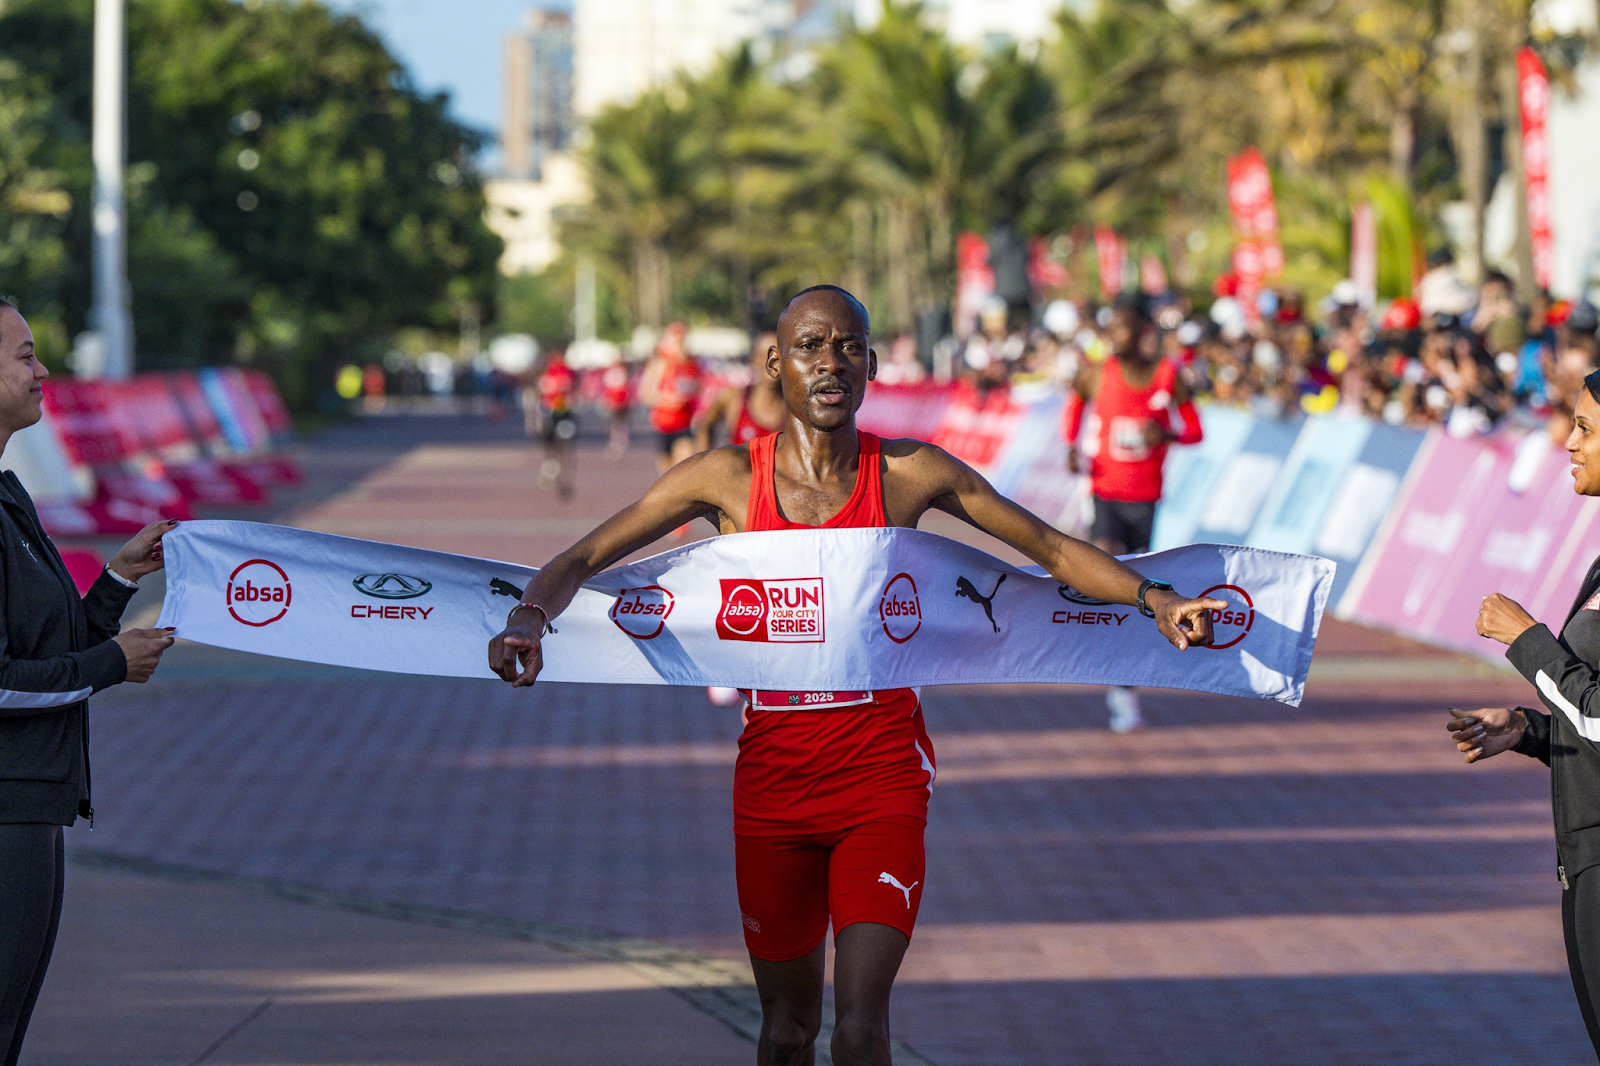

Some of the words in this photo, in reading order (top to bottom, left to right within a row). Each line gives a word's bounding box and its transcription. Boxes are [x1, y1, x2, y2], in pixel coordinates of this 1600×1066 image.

[234, 580, 284, 603] absa
[768, 587, 820, 609] RUN
[351, 605, 434, 620] CHERY
[619, 595, 669, 616] absa
[728, 600, 762, 618] absa
[884, 593, 917, 618] absa
[772, 609, 795, 619] YOUR
[795, 609, 817, 619] CITY
[1051, 611, 1129, 626] CHERY
[770, 618, 817, 633] SERIES
[804, 692, 834, 703] 2025
